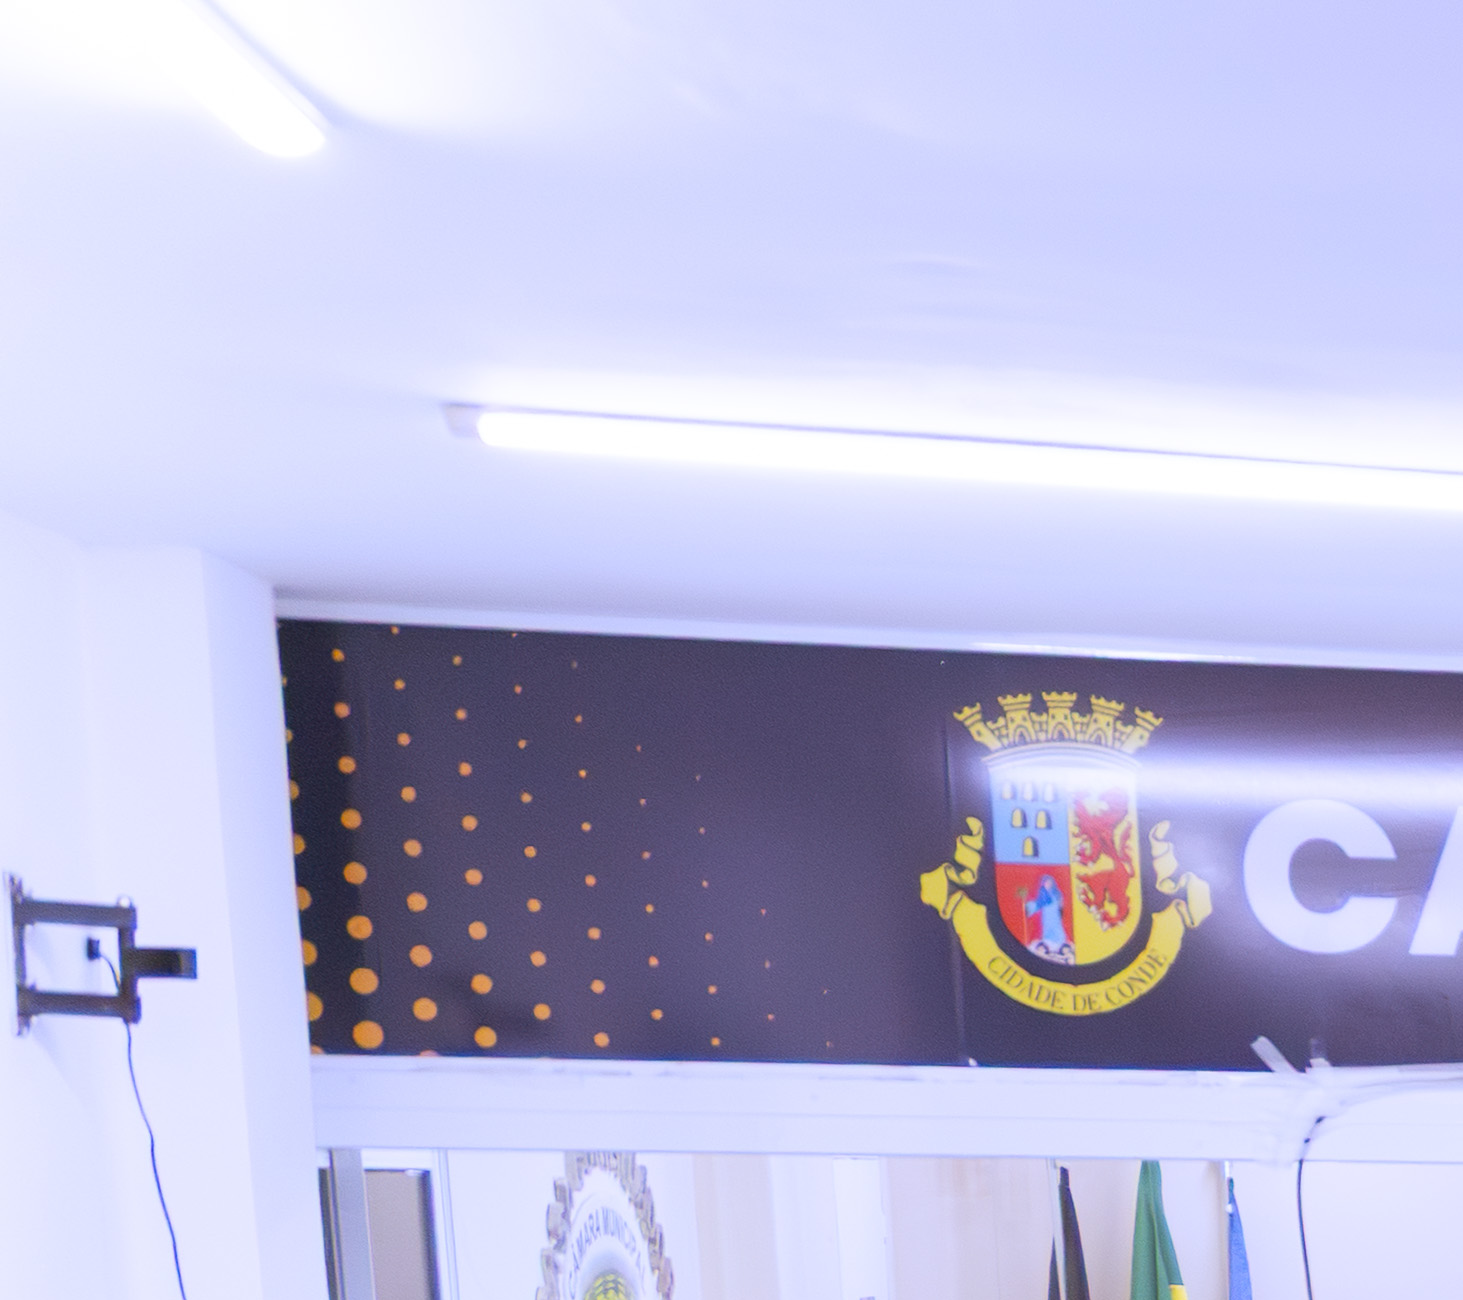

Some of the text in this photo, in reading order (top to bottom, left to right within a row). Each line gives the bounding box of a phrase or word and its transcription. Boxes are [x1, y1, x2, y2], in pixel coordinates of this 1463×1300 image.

[986, 948, 1168, 1012] CIDADE DE CONDE
